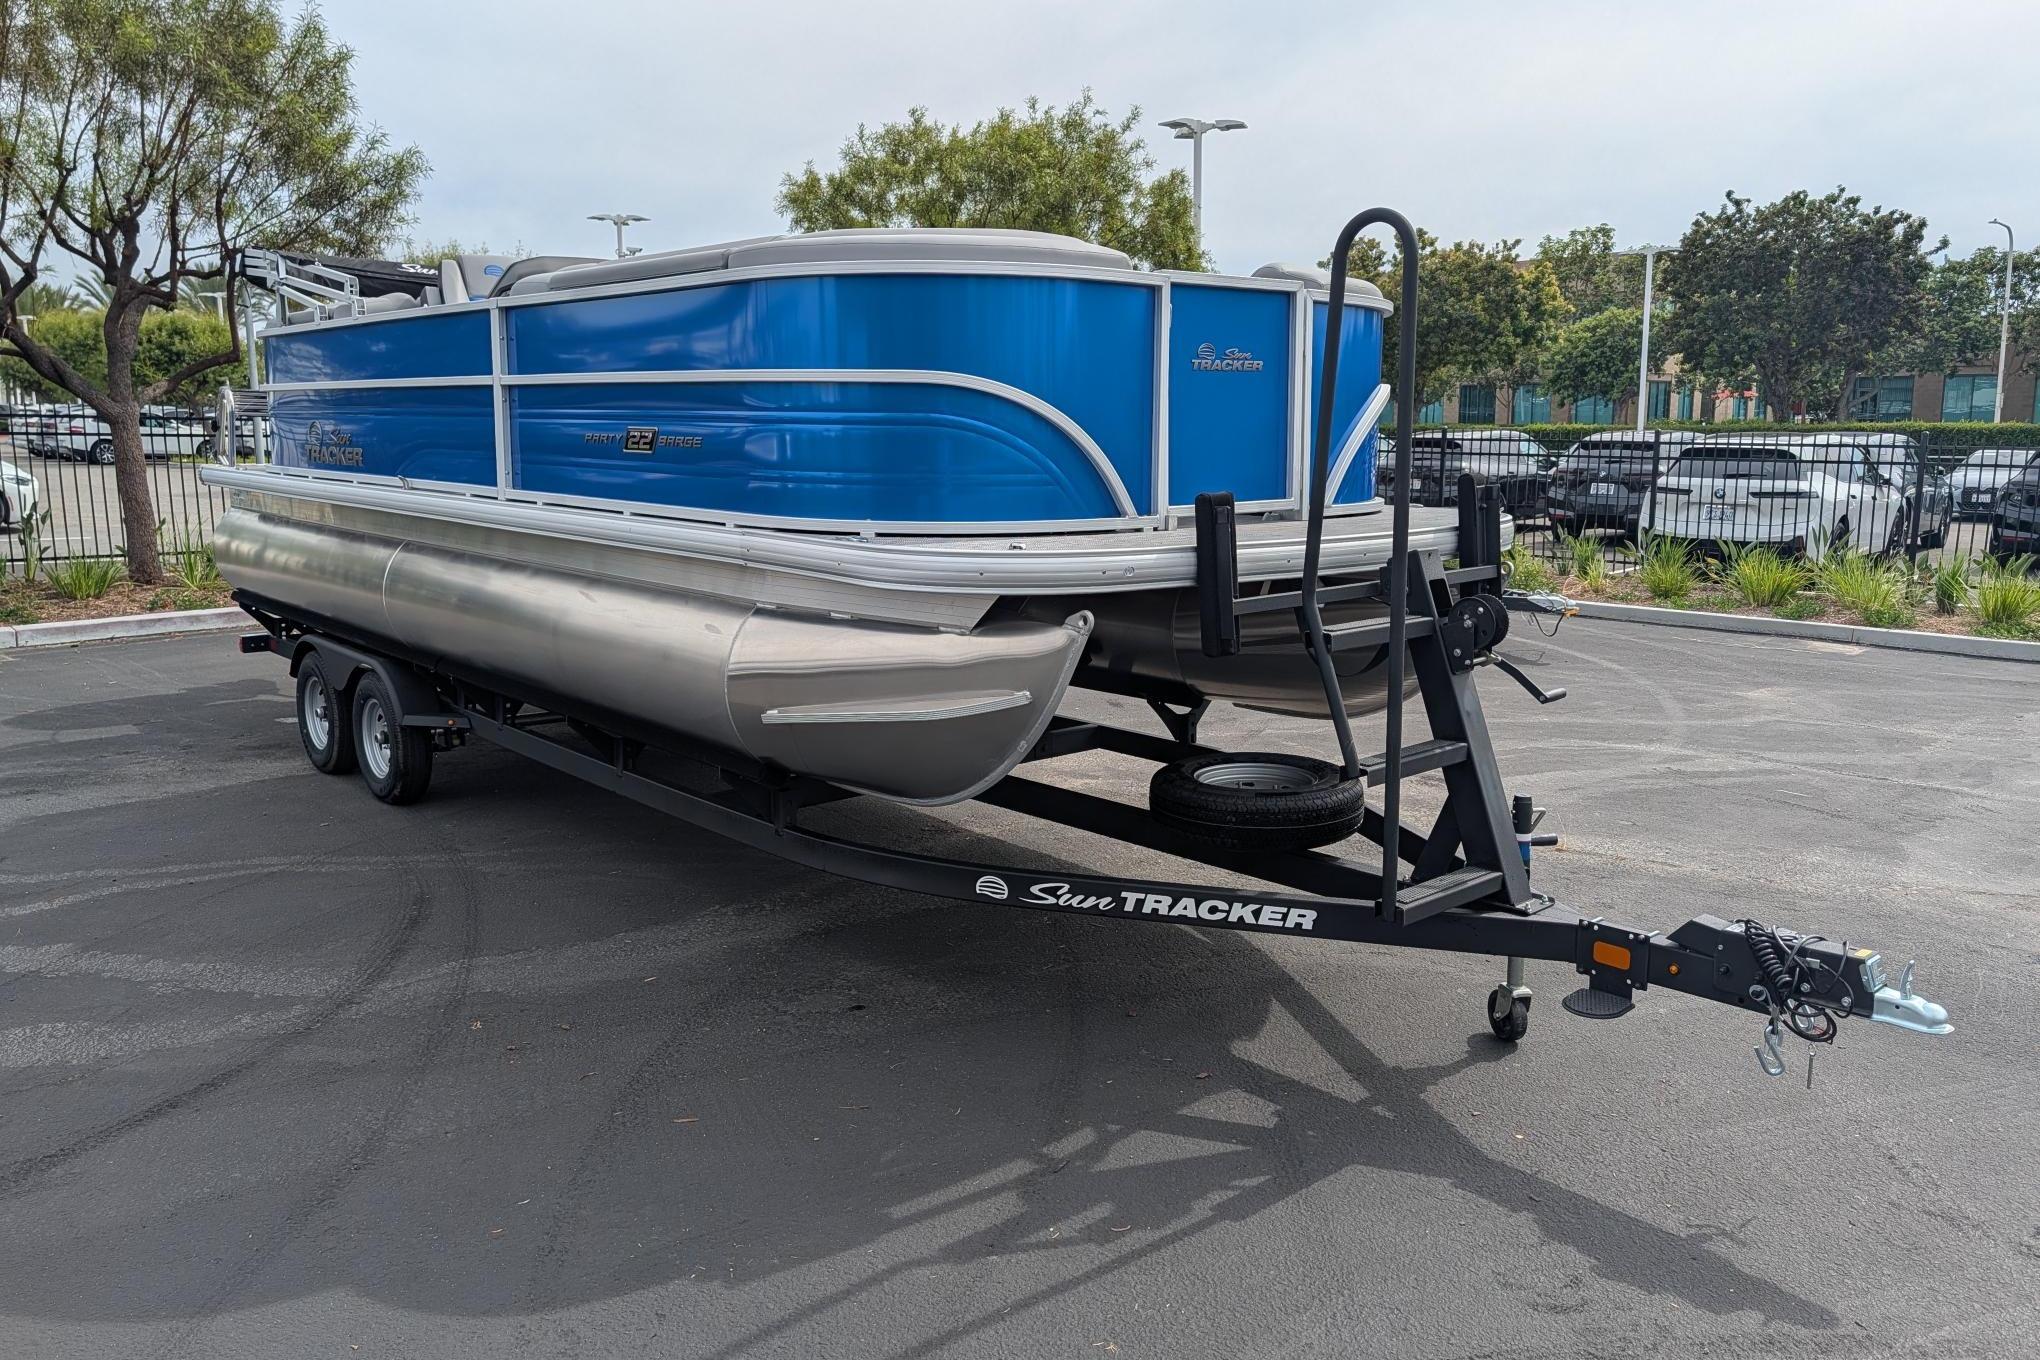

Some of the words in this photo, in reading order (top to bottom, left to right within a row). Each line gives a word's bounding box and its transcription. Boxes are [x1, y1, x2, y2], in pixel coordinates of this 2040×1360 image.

[1221, 348, 1253, 360] Sun
[1191, 359, 1264, 371] TRACKER
[585, 432, 624, 444] PARTY
[627, 431, 653, 449] 22
[658, 435, 703, 448] BARGE
[304, 444, 364, 467] TRACKER
[1017, 882, 1117, 913] Sun
[1119, 891, 1318, 931] TRACKER
